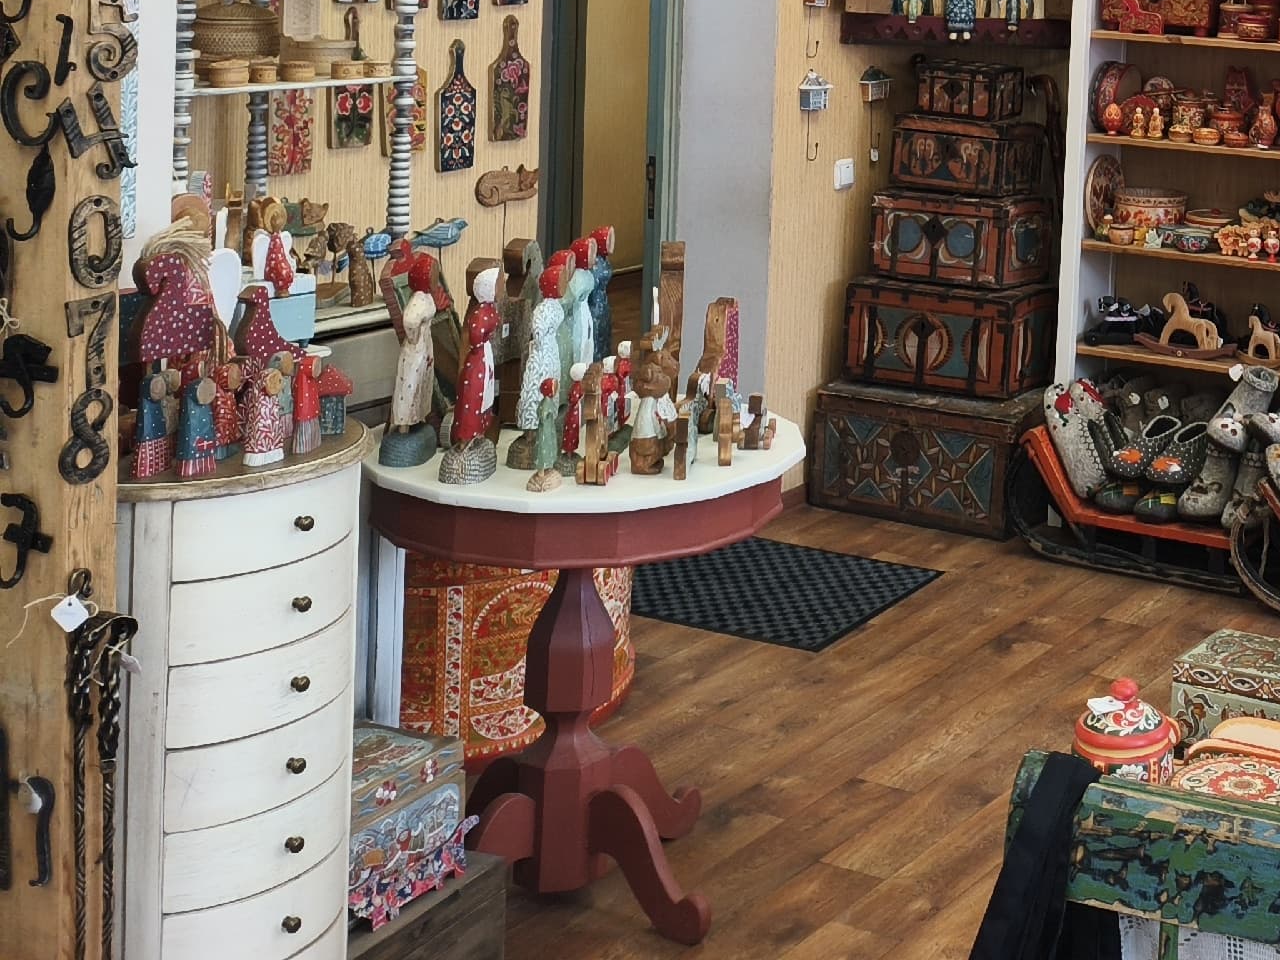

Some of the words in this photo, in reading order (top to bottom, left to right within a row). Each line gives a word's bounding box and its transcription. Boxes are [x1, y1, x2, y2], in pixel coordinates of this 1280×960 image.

[57, 80, 138, 180] 4
[64, 291, 116, 389] 7
[58, 388, 113, 485] 8
